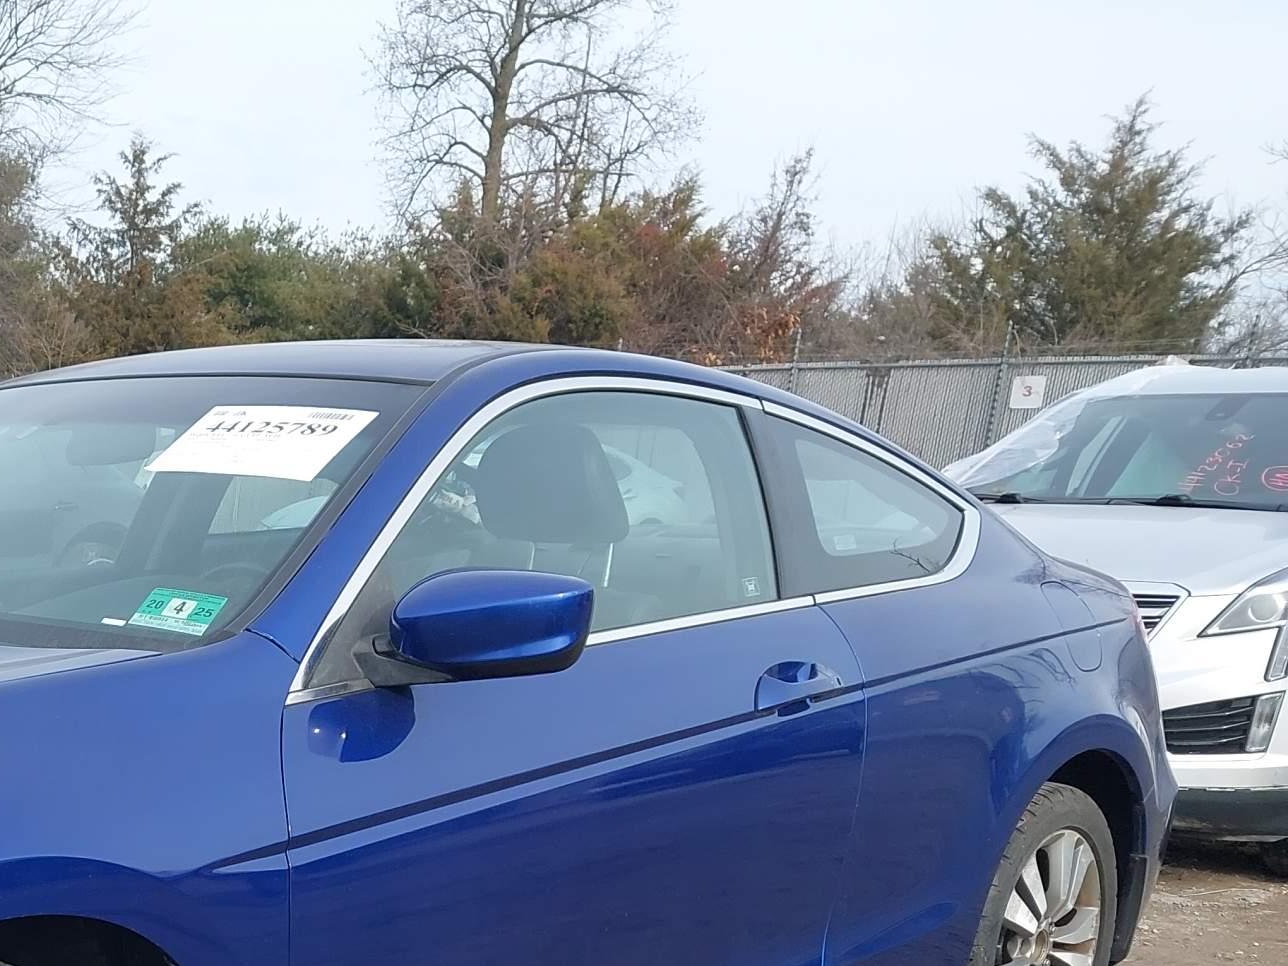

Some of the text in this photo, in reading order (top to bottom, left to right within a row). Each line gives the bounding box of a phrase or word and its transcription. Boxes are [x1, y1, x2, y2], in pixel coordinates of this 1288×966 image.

[1022, 385, 1033, 397] 3
[206, 420, 339, 436] 44125789
[145, 599, 215, 618] 20 4 25
